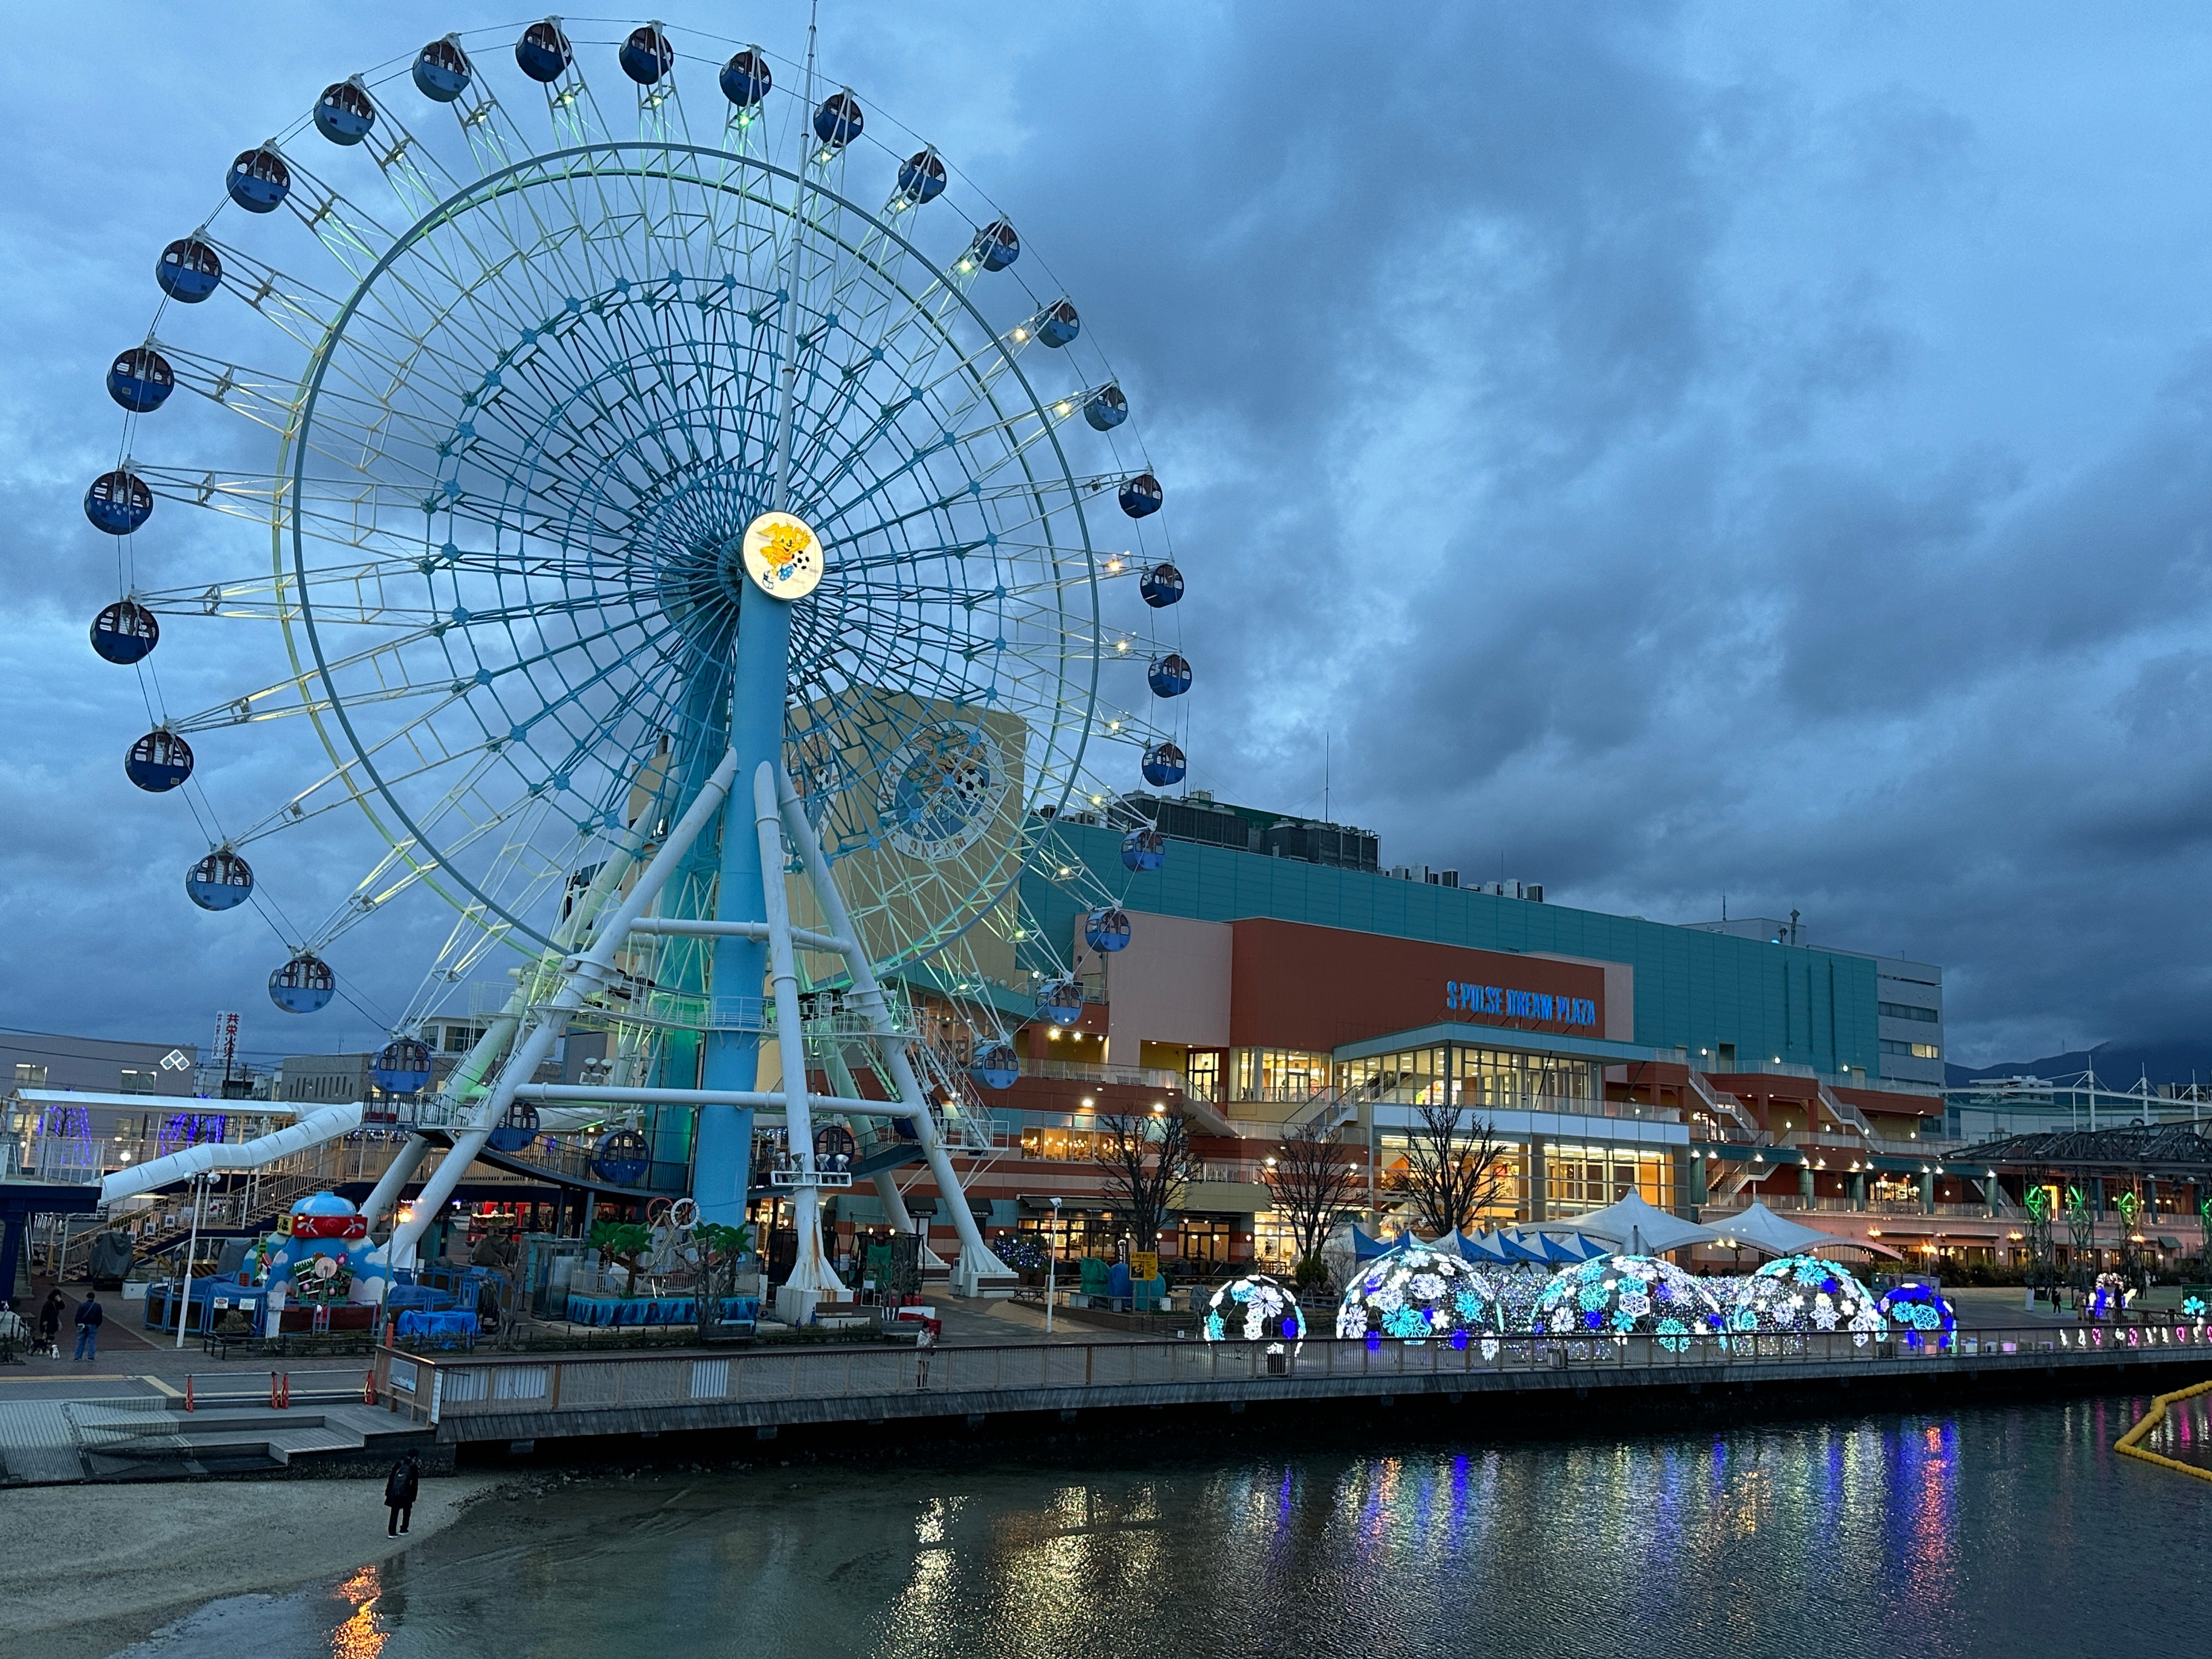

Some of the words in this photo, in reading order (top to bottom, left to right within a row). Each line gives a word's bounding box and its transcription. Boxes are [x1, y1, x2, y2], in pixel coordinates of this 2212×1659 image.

[909, 832, 967, 857] DREAM
[1447, 980, 1503, 1015] S-PULSE
[1506, 989, 1553, 1020] DREAM
[1556, 995, 1596, 1026] PLAZA
